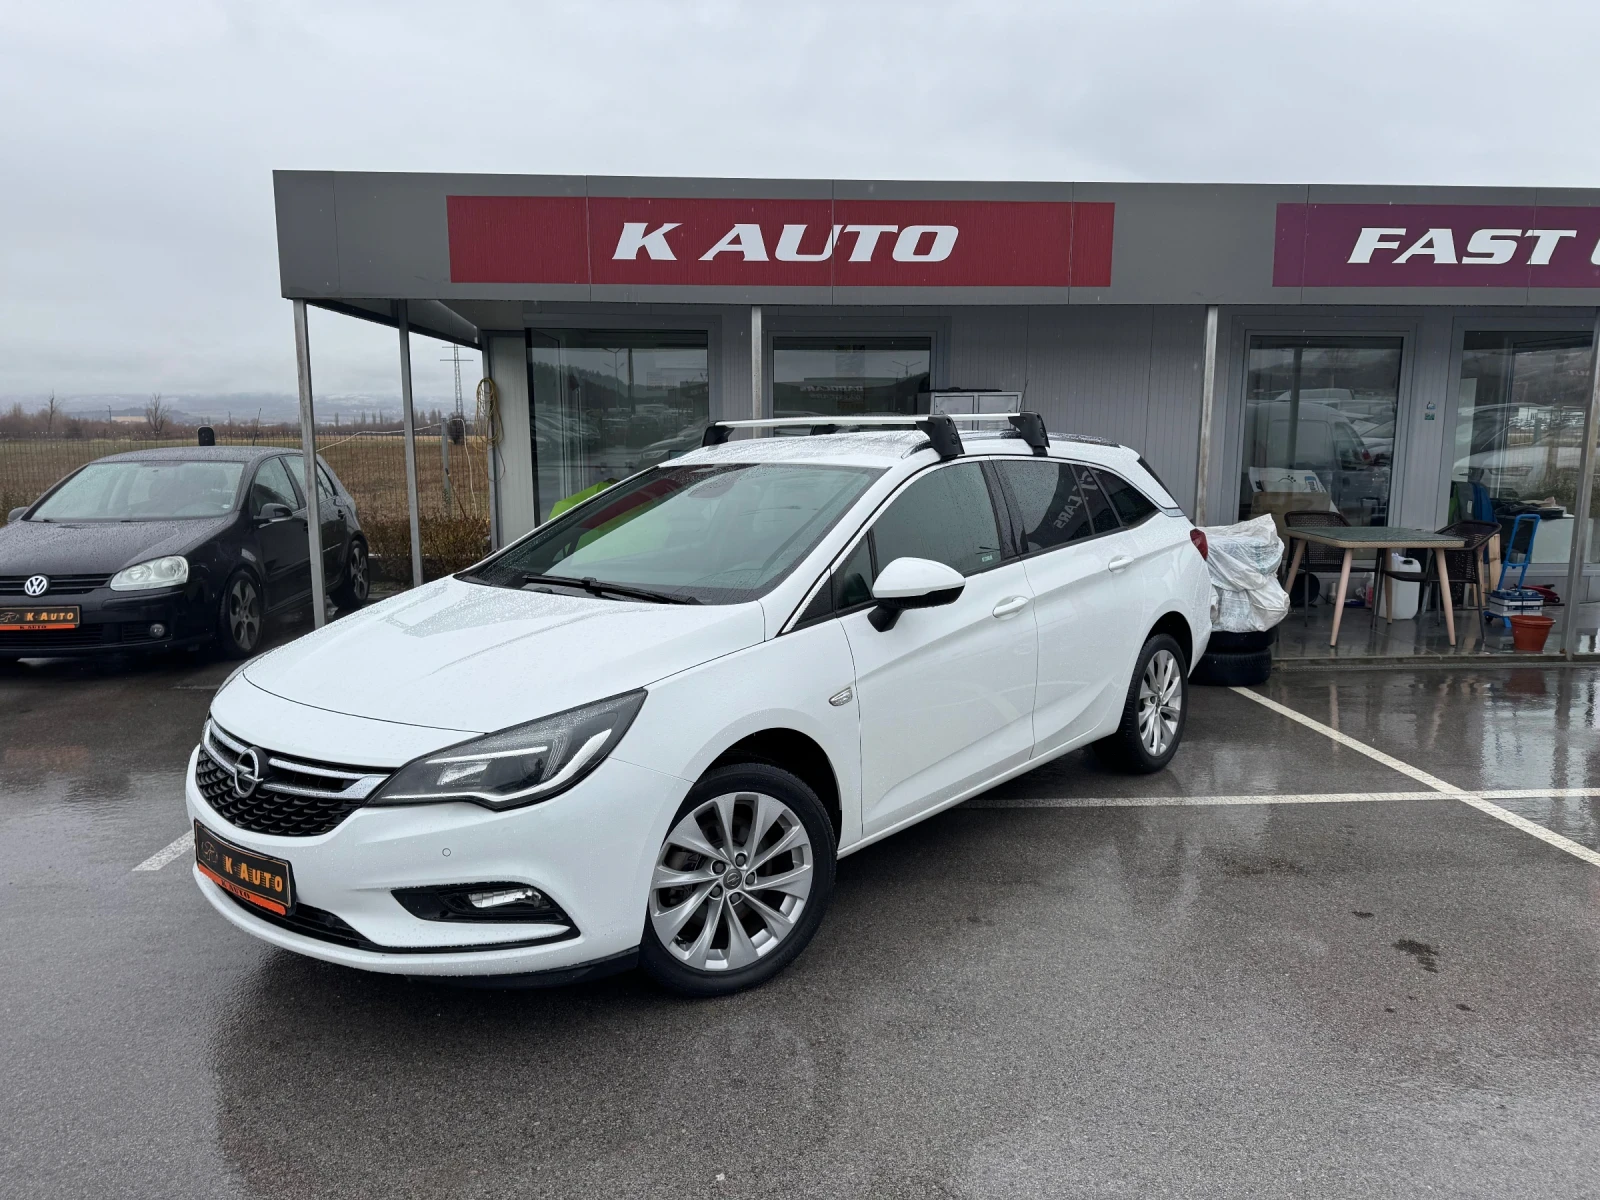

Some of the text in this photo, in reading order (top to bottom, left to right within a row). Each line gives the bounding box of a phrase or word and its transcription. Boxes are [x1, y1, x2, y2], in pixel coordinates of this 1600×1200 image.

[612, 222, 959, 262] K AUTO
[1347, 227, 1577, 265] FAST
[25, 576, 47, 595] VW
[26, 612, 34, 621] K
[224, 855, 283, 893] K AUTO
